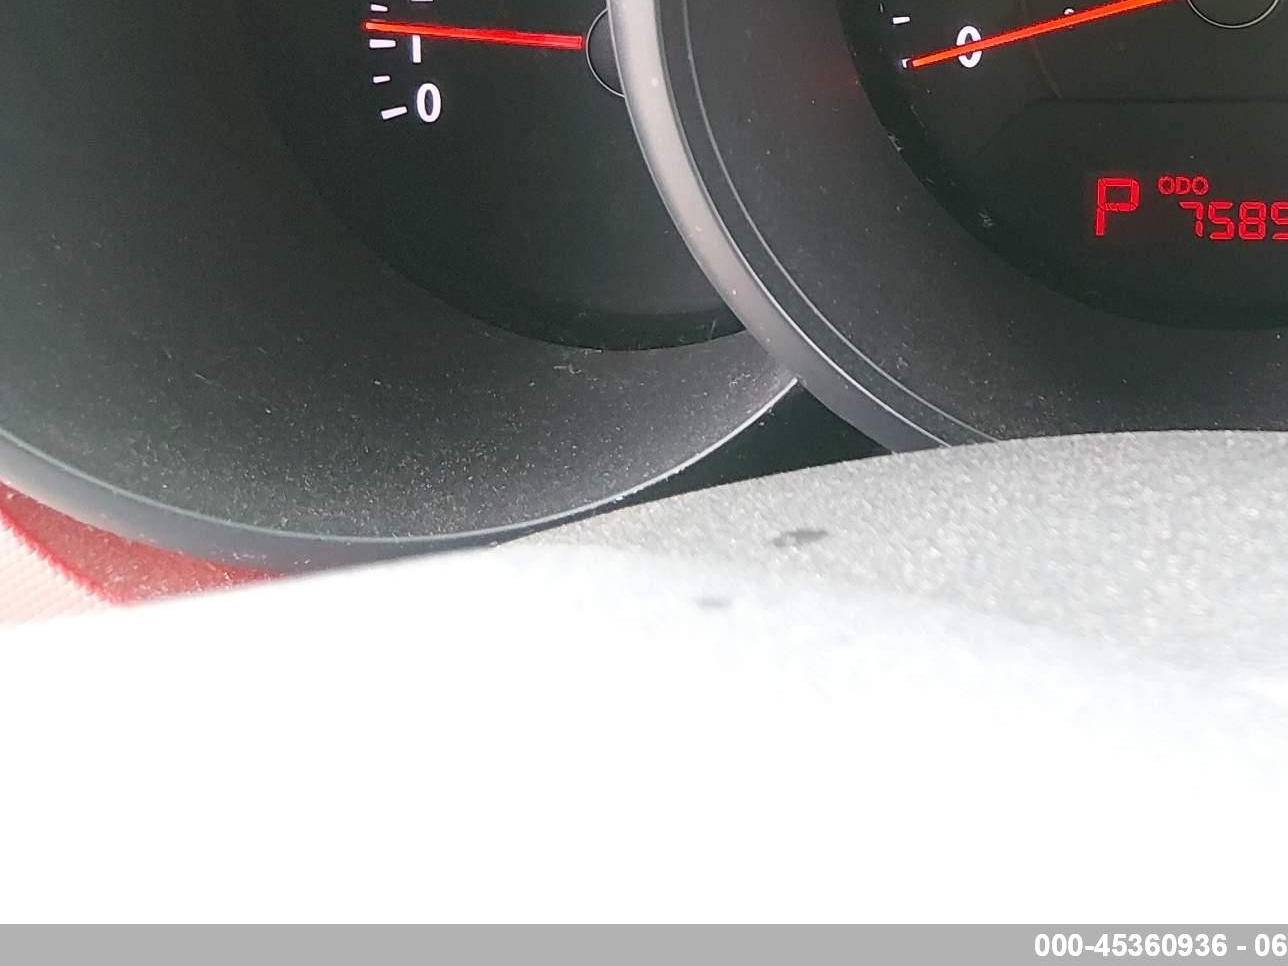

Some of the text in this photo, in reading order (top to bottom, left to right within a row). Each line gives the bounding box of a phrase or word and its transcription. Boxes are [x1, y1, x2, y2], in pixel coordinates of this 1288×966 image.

[955, 25, 983, 69] 0
[416, 82, 443, 124] 0
[1095, 177, 1140, 237] P
[1157, 176, 1209, 196] ODO
